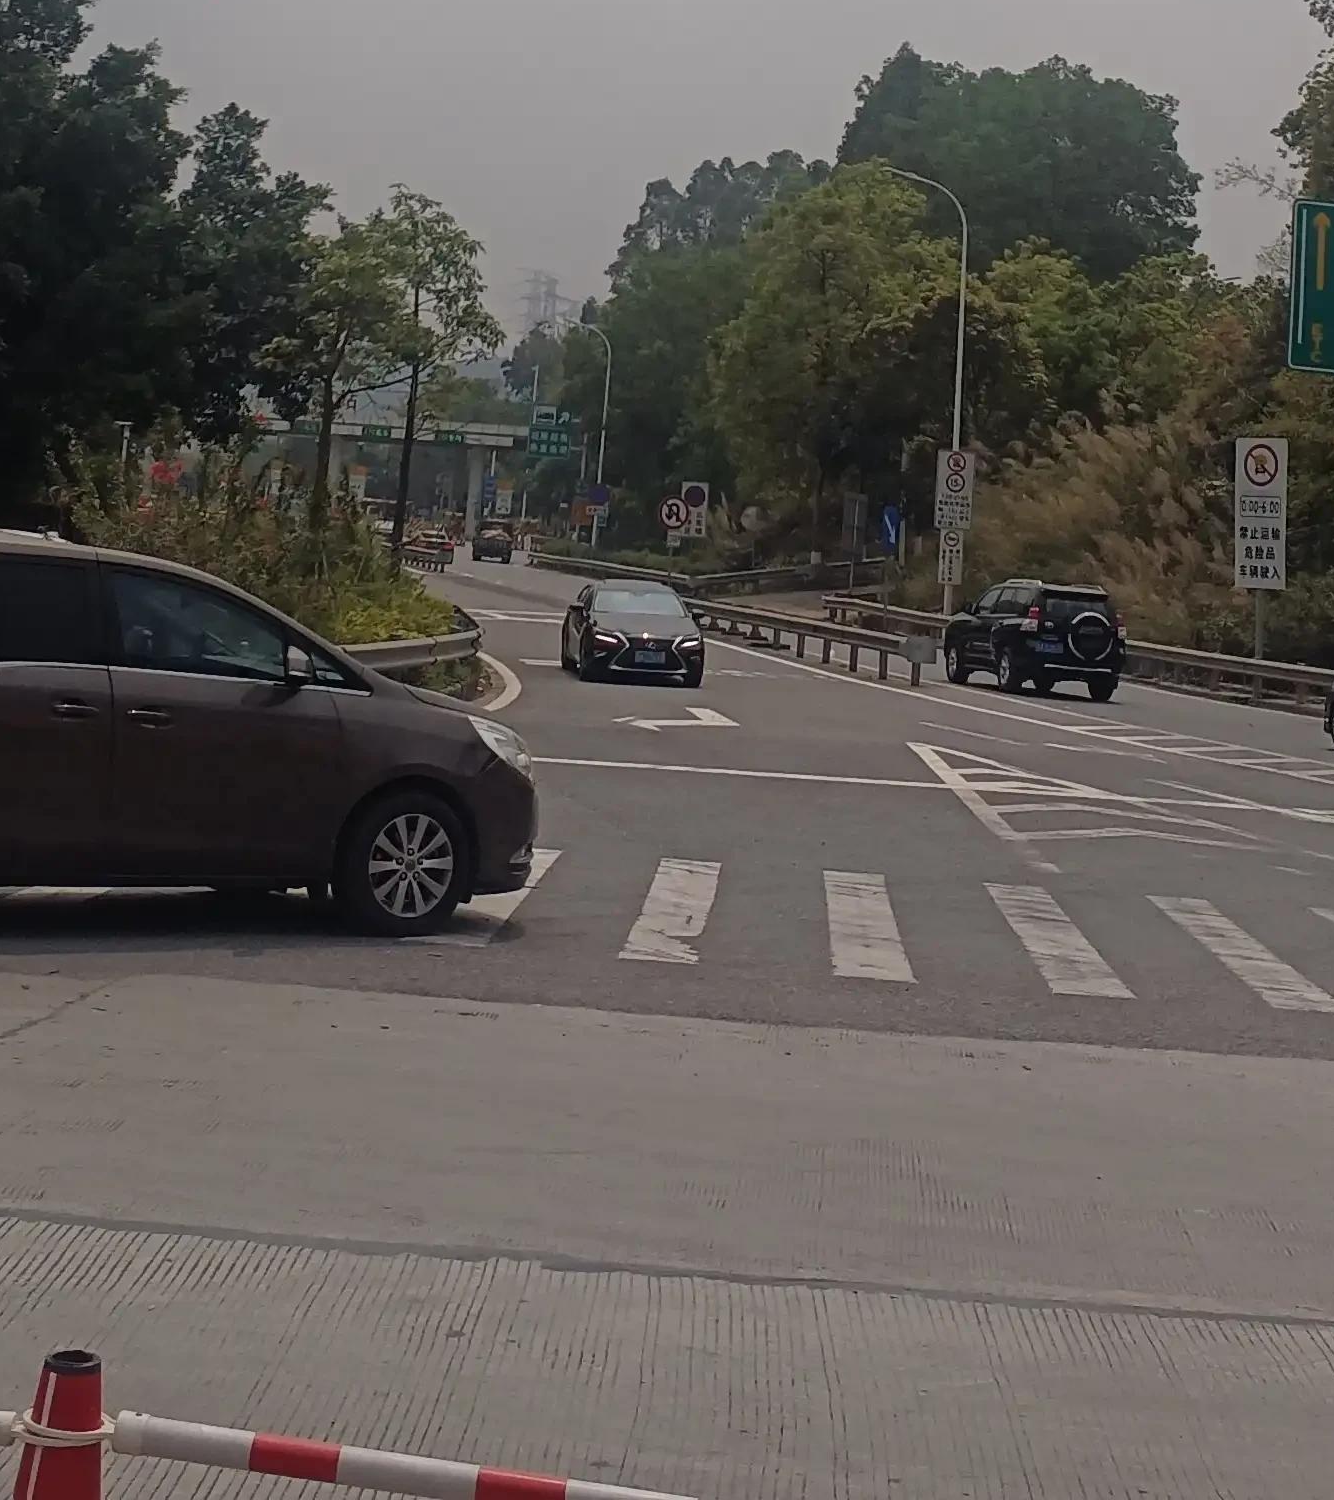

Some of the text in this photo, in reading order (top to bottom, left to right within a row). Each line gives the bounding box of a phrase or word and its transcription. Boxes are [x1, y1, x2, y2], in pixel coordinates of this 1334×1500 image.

[1240, 526, 1281, 541] 禁止运输
[1245, 546, 1276, 560] 危险品
[1239, 565, 1281, 580] 车辆驶入
